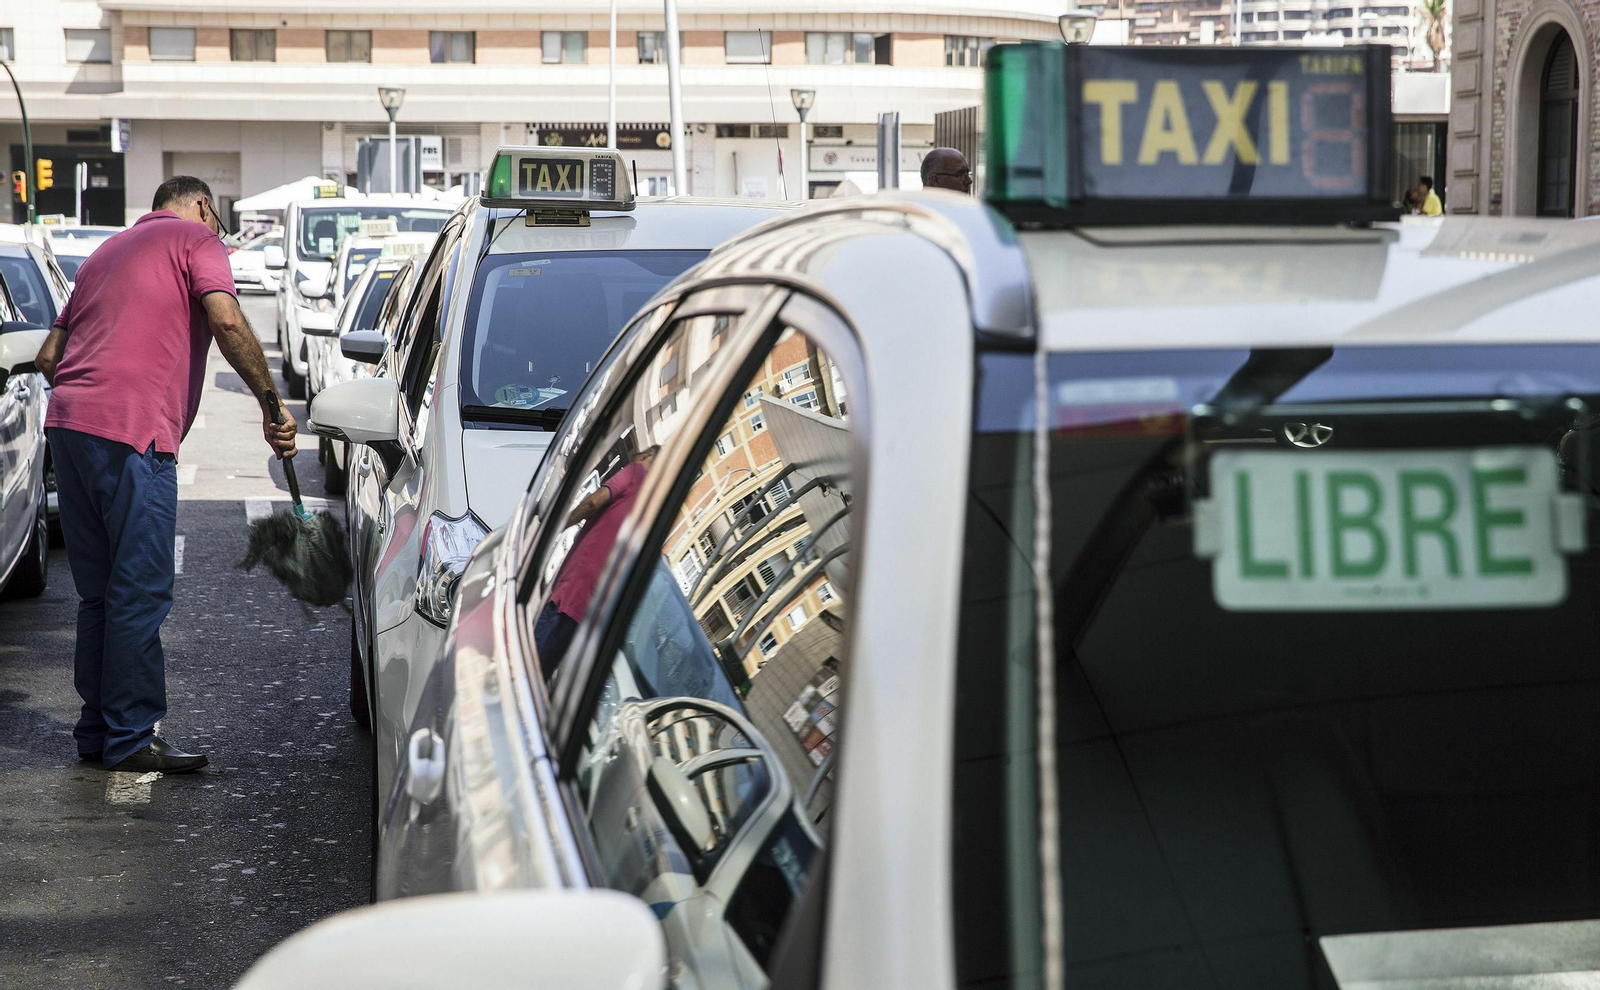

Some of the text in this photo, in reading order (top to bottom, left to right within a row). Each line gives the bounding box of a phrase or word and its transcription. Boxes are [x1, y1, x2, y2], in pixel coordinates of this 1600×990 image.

[1299, 55, 1363, 75] TARIFA
[1081, 79, 1291, 166] TAXI
[521, 163, 581, 193] TAXI
[1233, 467, 1536, 580] LIBRE
